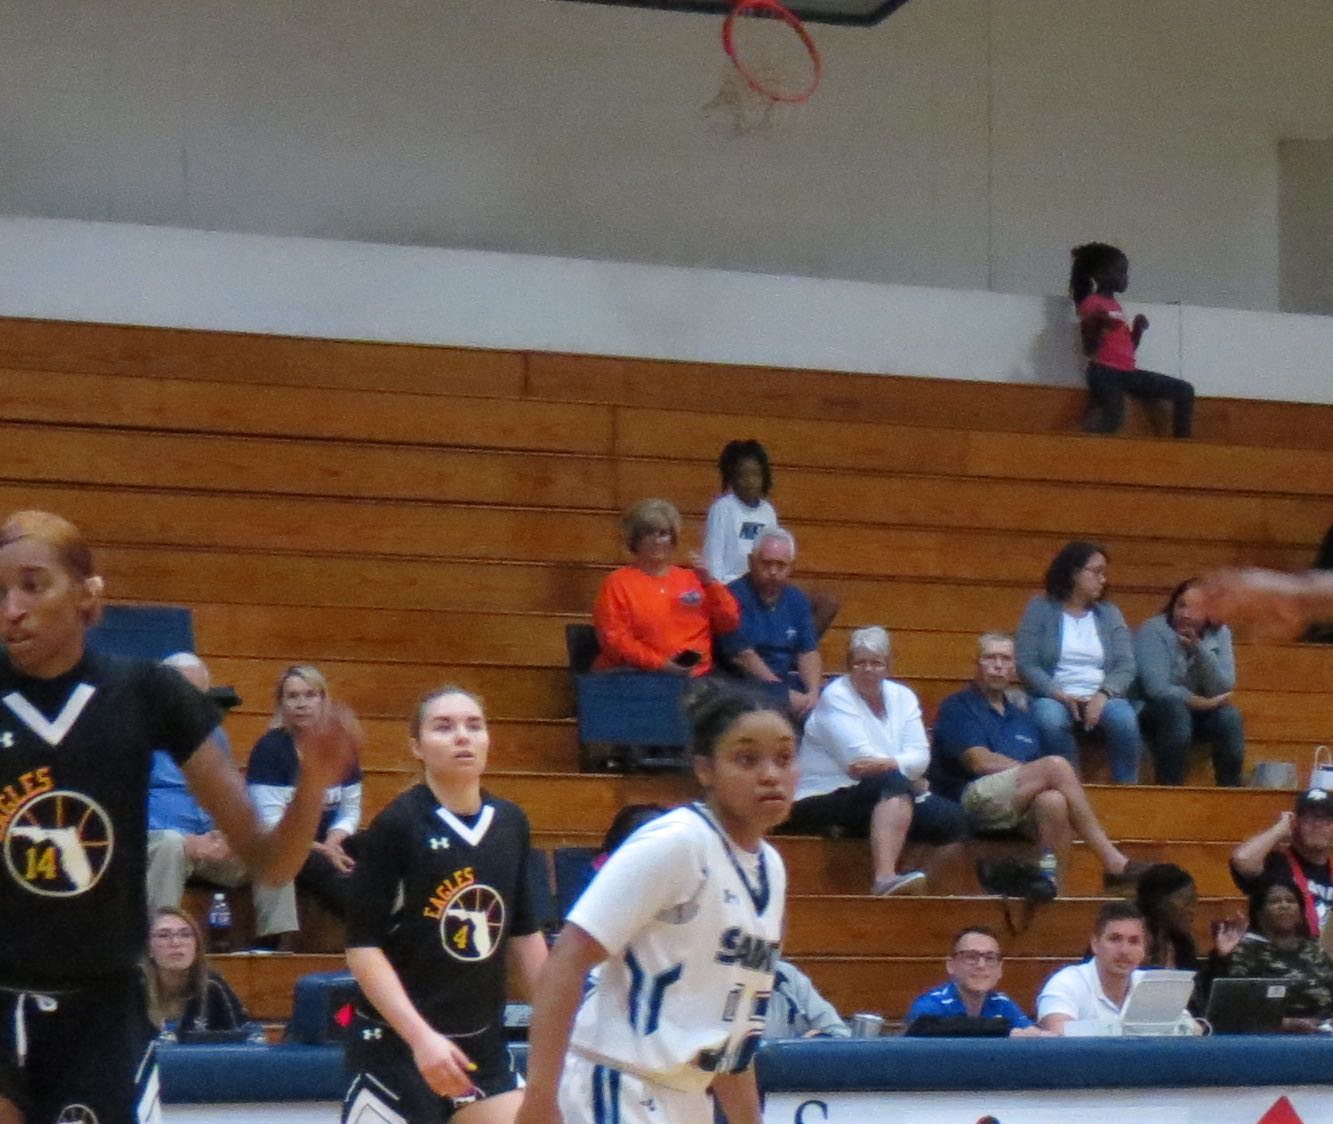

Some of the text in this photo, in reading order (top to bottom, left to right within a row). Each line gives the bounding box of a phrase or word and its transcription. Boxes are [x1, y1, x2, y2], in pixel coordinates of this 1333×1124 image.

[25, 847, 57, 881] 14
[422, 867, 475, 920] EAGLES
[452, 924, 470, 950] 4
